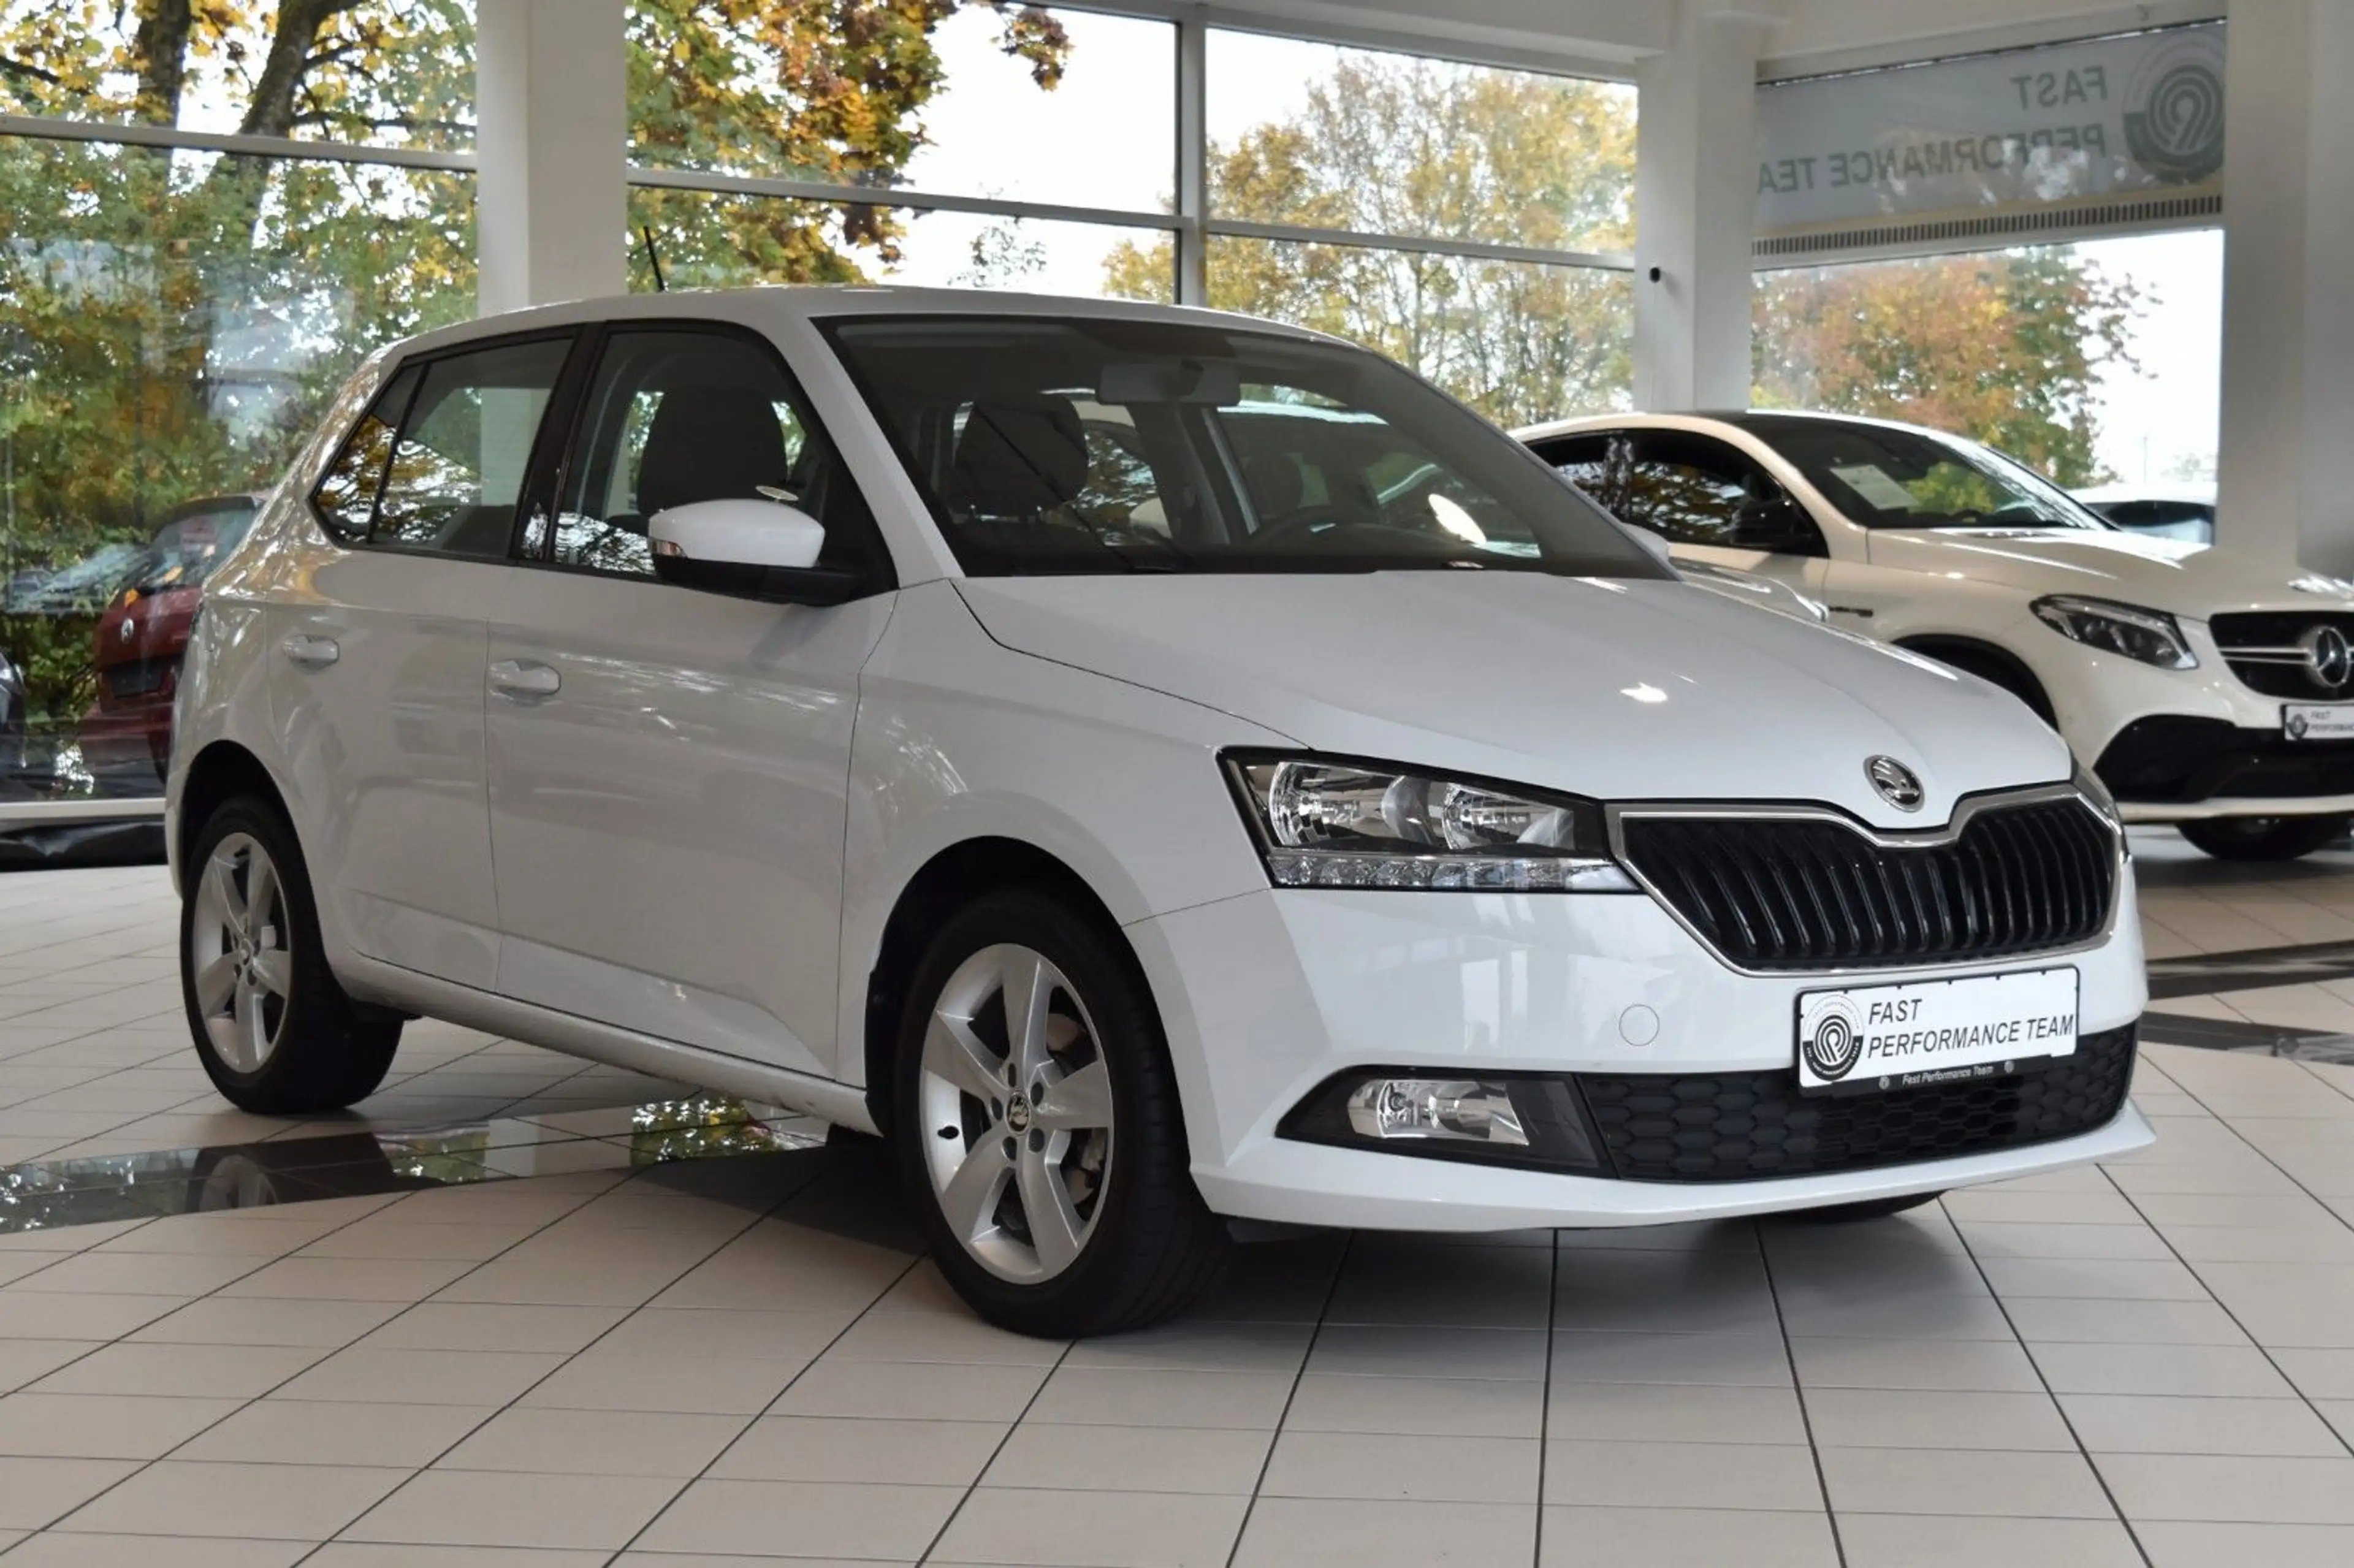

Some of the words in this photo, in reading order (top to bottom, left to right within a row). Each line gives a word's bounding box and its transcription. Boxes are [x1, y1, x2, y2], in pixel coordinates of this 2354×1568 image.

[1868, 999, 1922, 1025] FAST
[1867, 1021, 2021, 1059] PERFORMANCE
[2027, 1014, 2074, 1040] TEAM
